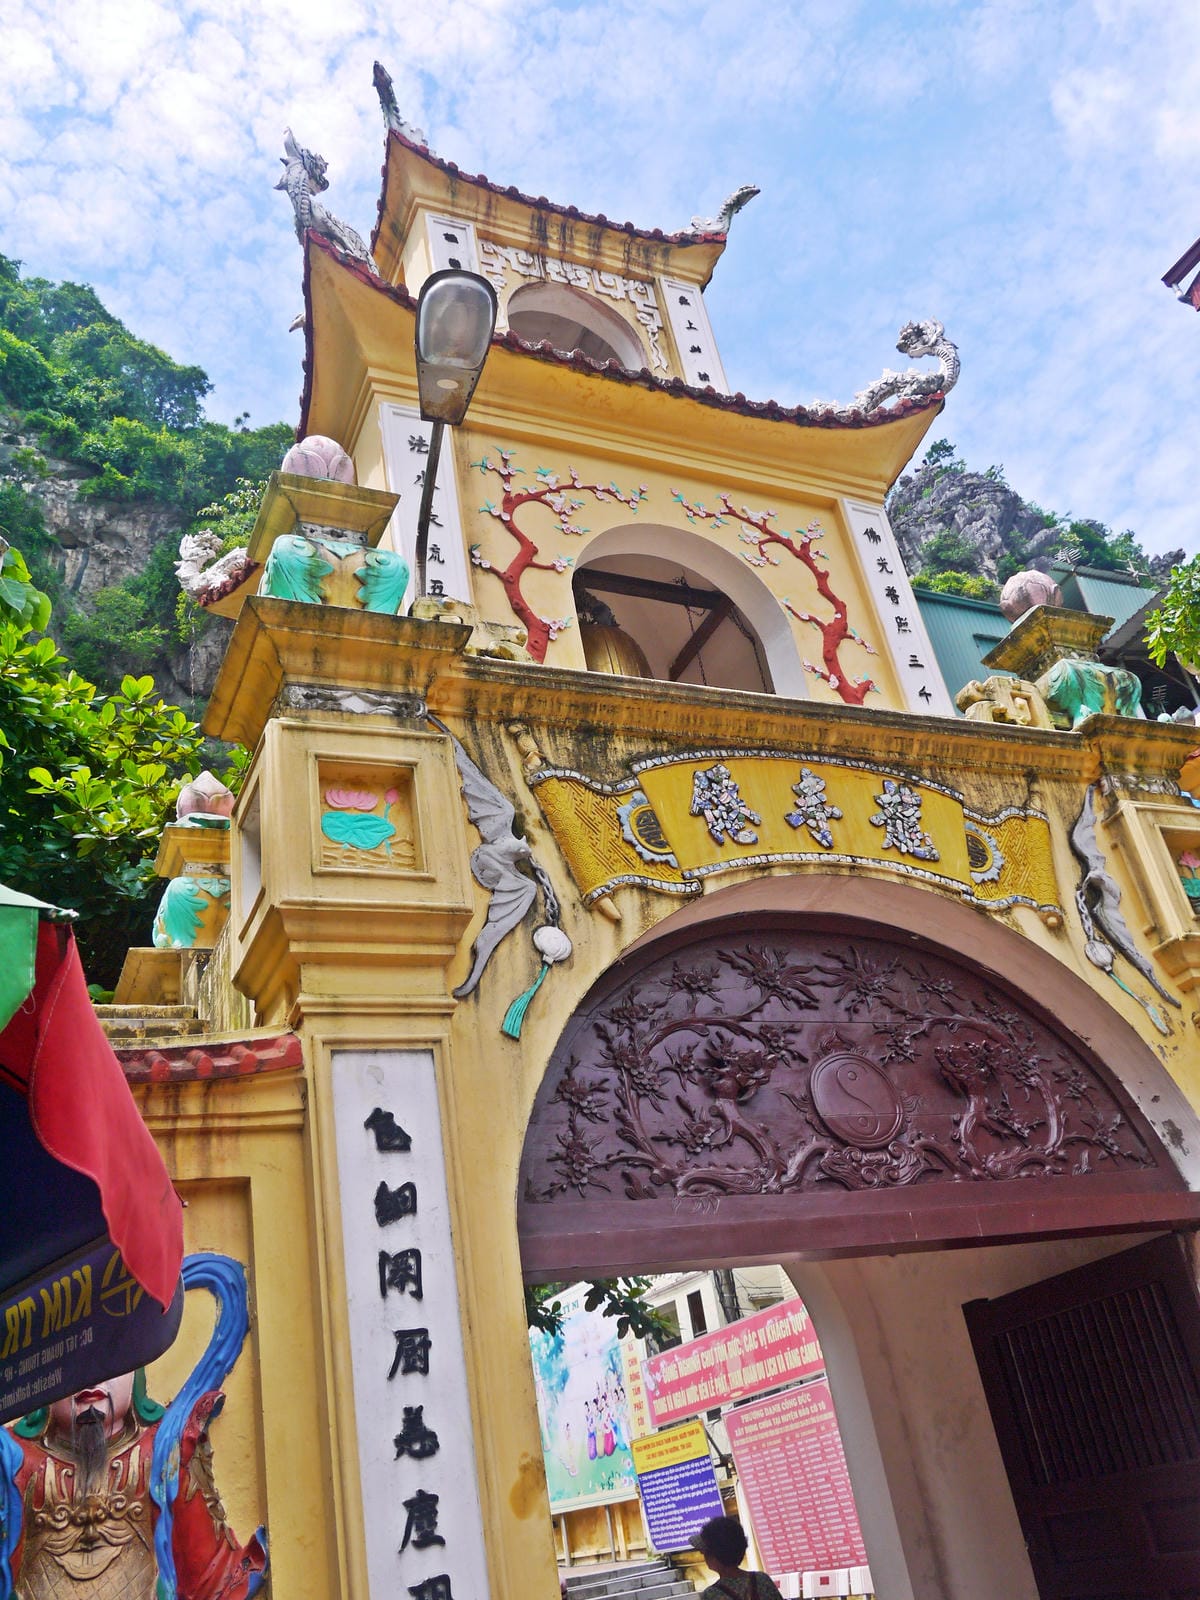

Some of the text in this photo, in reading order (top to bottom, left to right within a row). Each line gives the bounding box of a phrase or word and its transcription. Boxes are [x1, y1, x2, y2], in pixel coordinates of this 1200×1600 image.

[743, 1329, 759, 1352] CÁC
[757, 1327, 768, 1349] VỊ
[766, 1318, 791, 1344] KHÁCH
